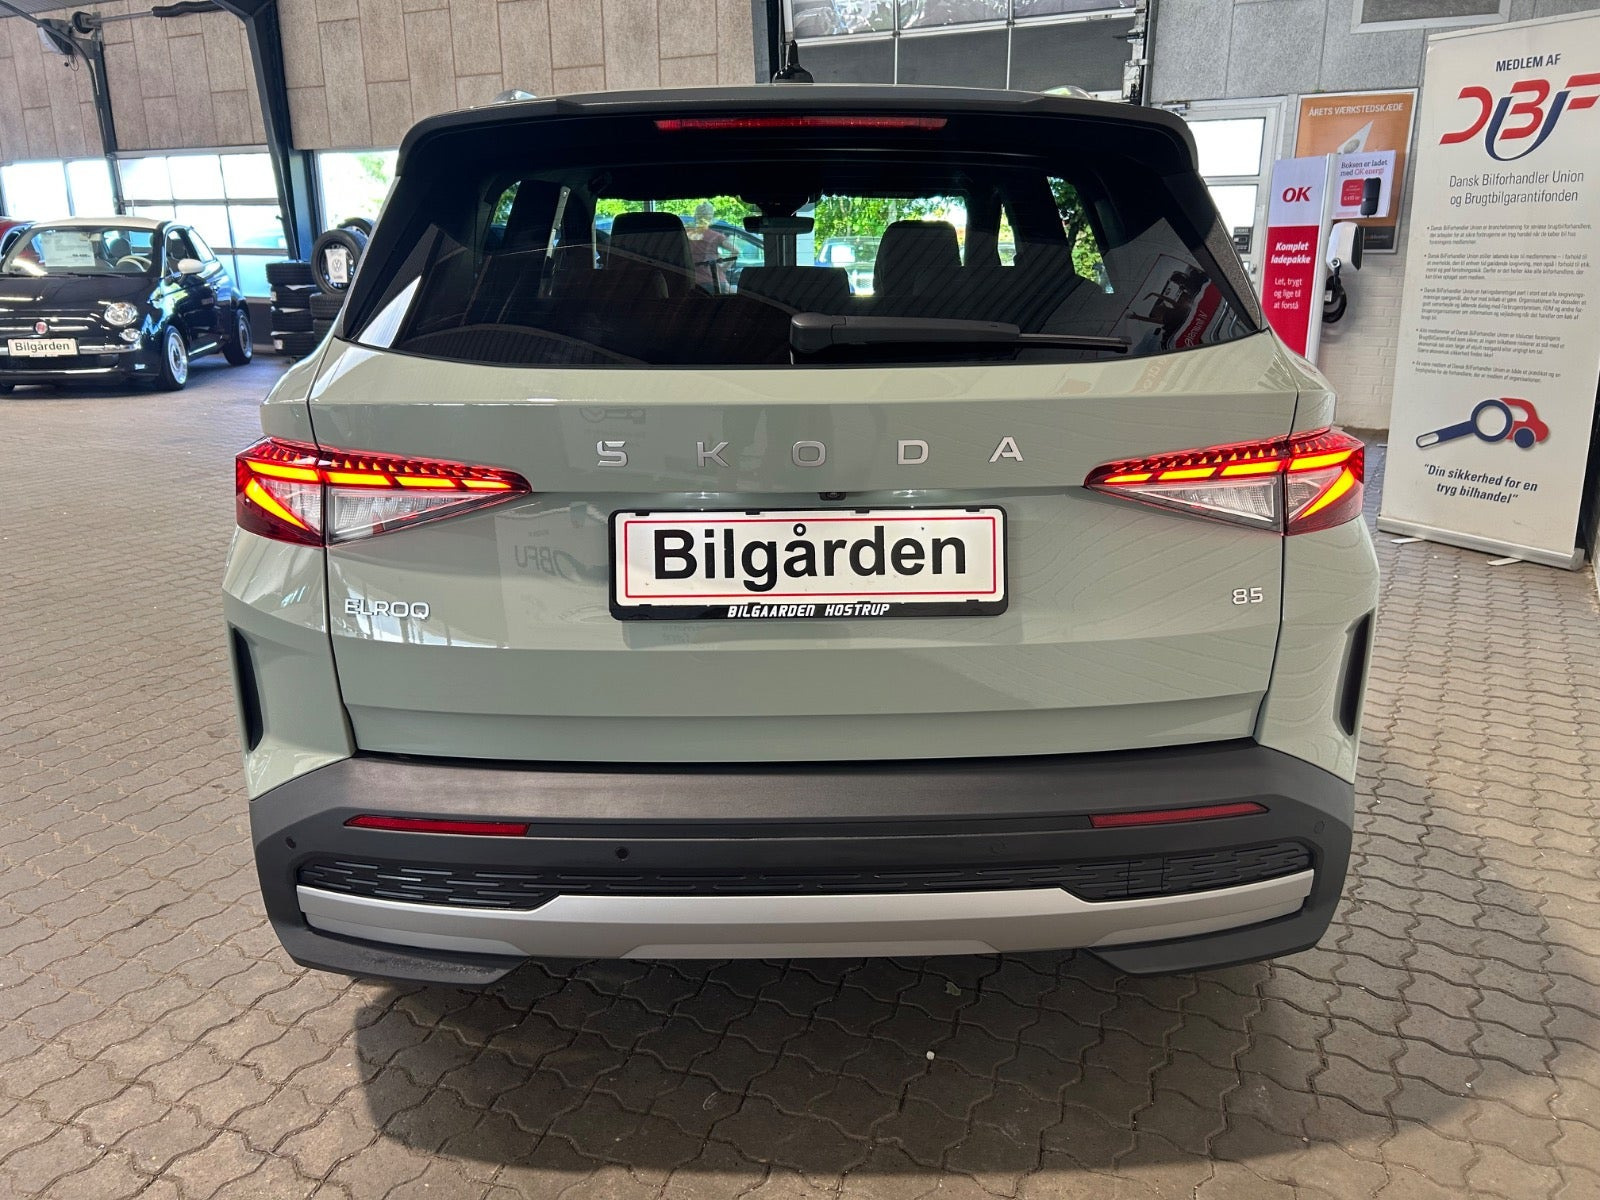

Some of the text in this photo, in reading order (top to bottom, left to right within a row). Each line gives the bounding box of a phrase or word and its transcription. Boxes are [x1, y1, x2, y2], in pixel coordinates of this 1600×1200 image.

[1496, 53, 1561, 71] MEDLEM AF
[1308, 102, 1404, 117] ÅRETS VÆRKSTEDSKÆDE
[1341, 161, 1363, 169] Boksen
[1449, 170, 1584, 188] Dansk Bilforhandler Union
[1282, 186, 1312, 203] OK
[1450, 189, 1578, 207] og Brugtbilgarantifonden
[1275, 241, 1309, 253] Komplet
[1271, 254, 1311, 266] ladepakke
[1274, 278, 1302, 287] Let, trygt
[1274, 290, 1281, 298] og
[1282, 288, 1295, 299] lige
[1281, 301, 1299, 310] forstå
[15, 341, 70, 353] Bilgården
[1447, 468, 1503, 486] sikkerhed
[1504, 476, 1521, 489] for
[1523, 482, 1538, 491] en
[1436, 483, 1457, 496] tryg
[653, 523, 966, 592] Bilgården
[1232, 587, 1264, 605] 85
[344, 598, 430, 620] ELROQ
[727, 602, 890, 618] BILGAARDEN HOSTRUP
